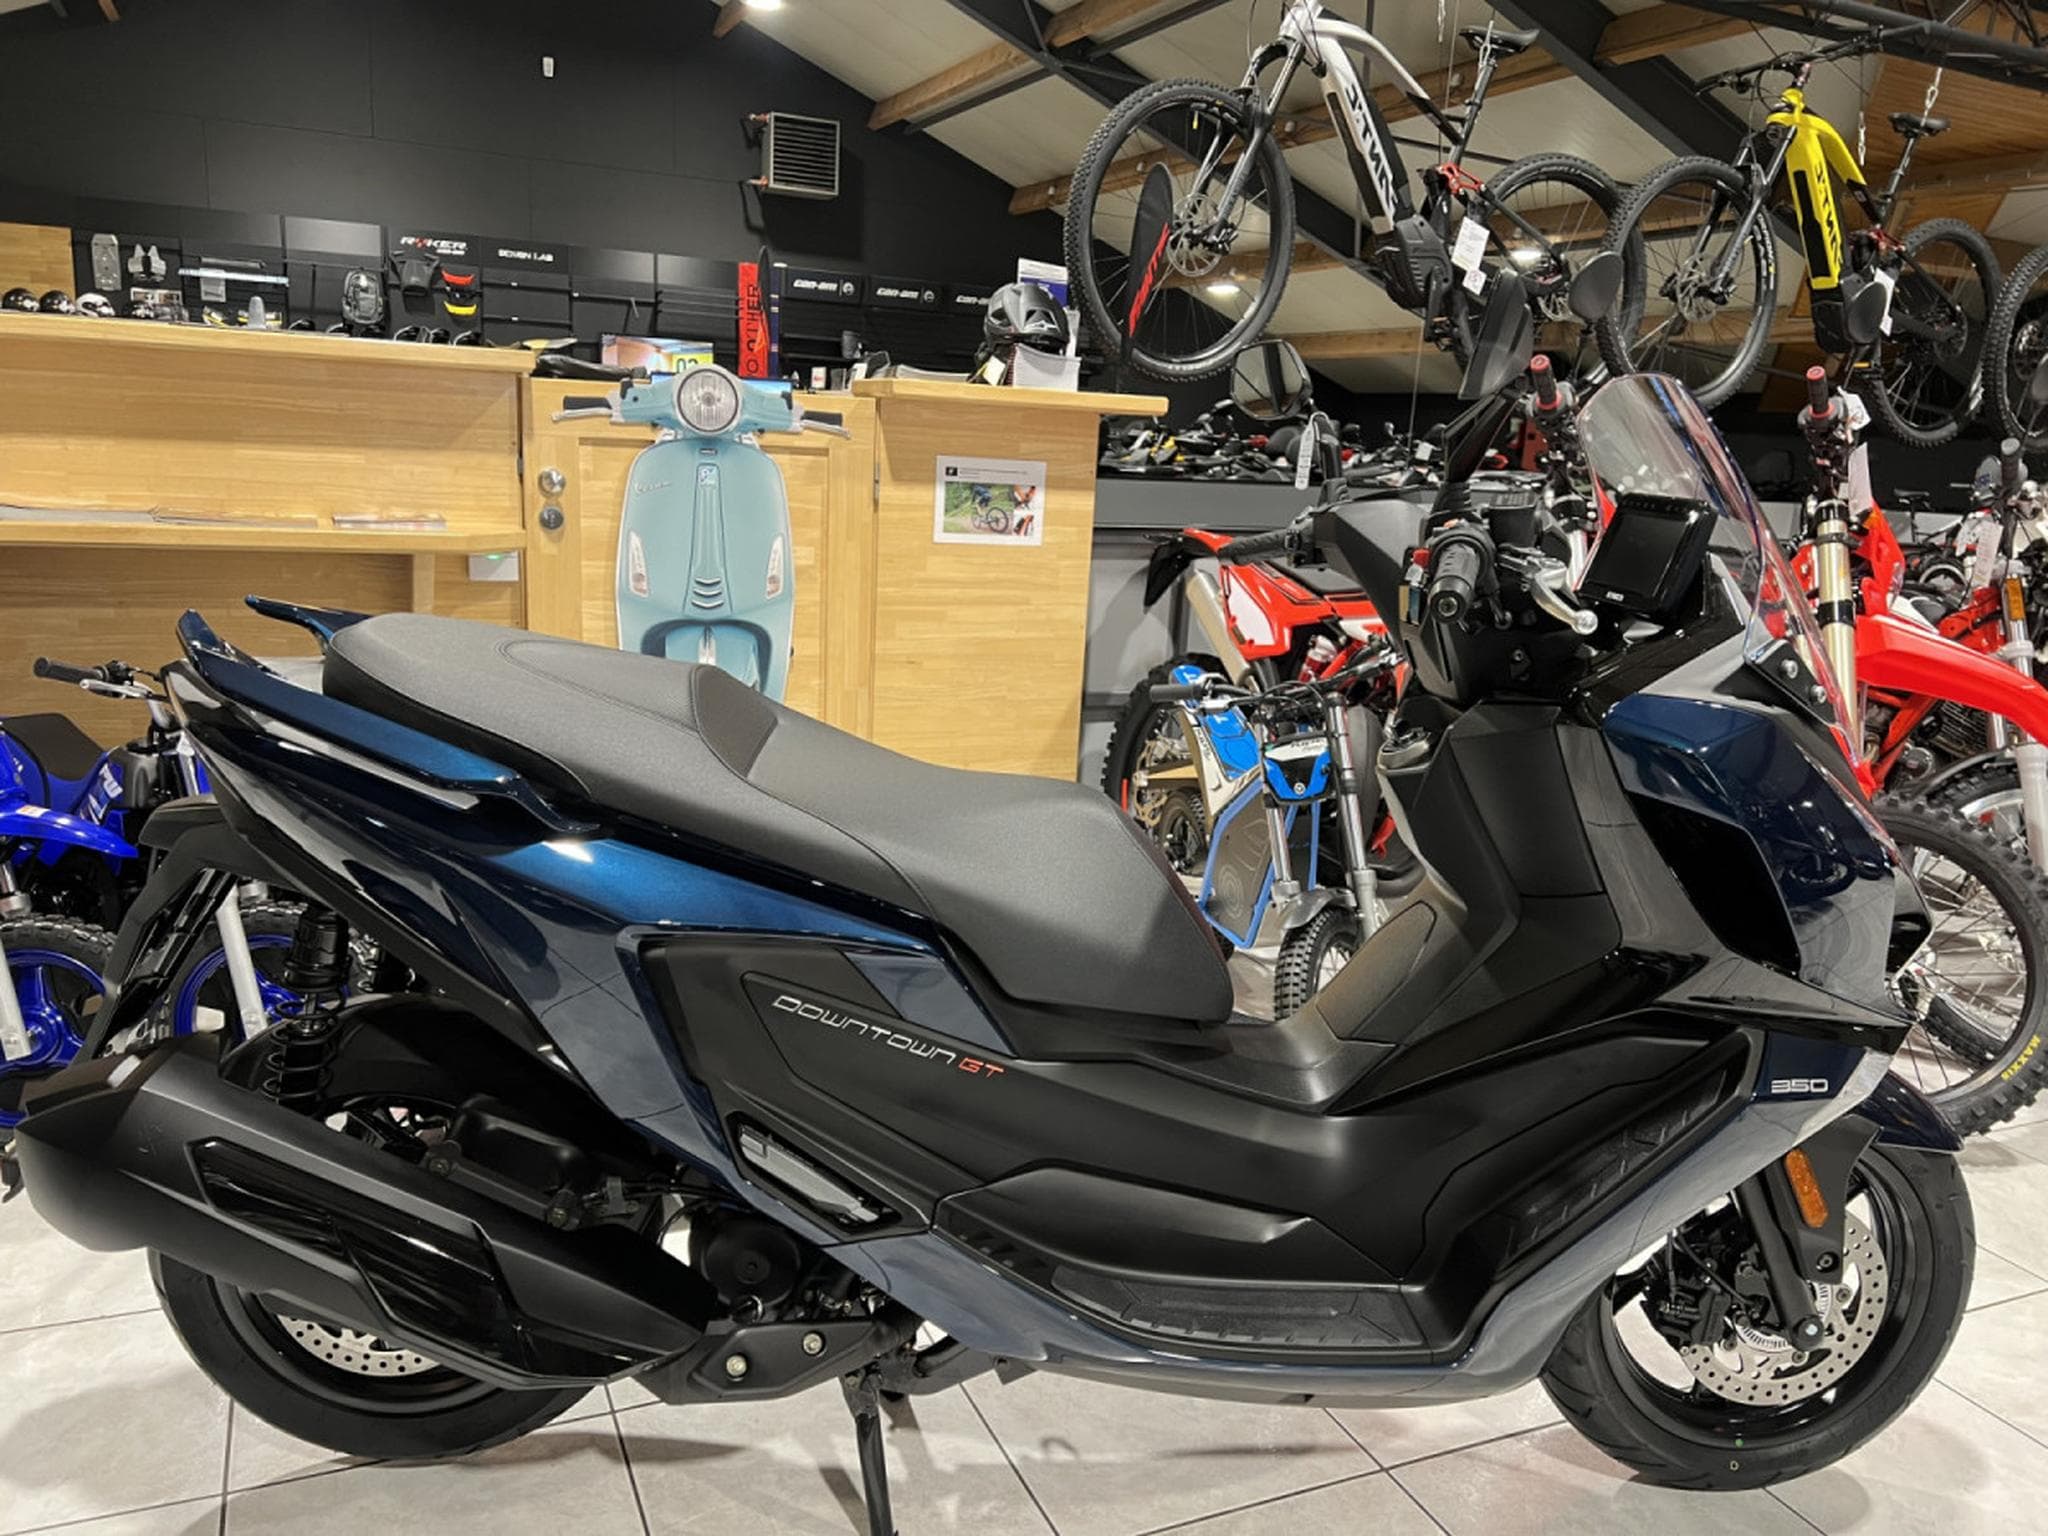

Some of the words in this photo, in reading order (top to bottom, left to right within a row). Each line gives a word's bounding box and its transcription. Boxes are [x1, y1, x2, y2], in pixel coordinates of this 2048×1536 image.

[772, 995, 956, 1064] DOWNTOWN
[958, 1057, 1004, 1077] GT
[2000, 1034, 2040, 1080] MAXXIS
[1771, 1078, 1828, 1093] 350
